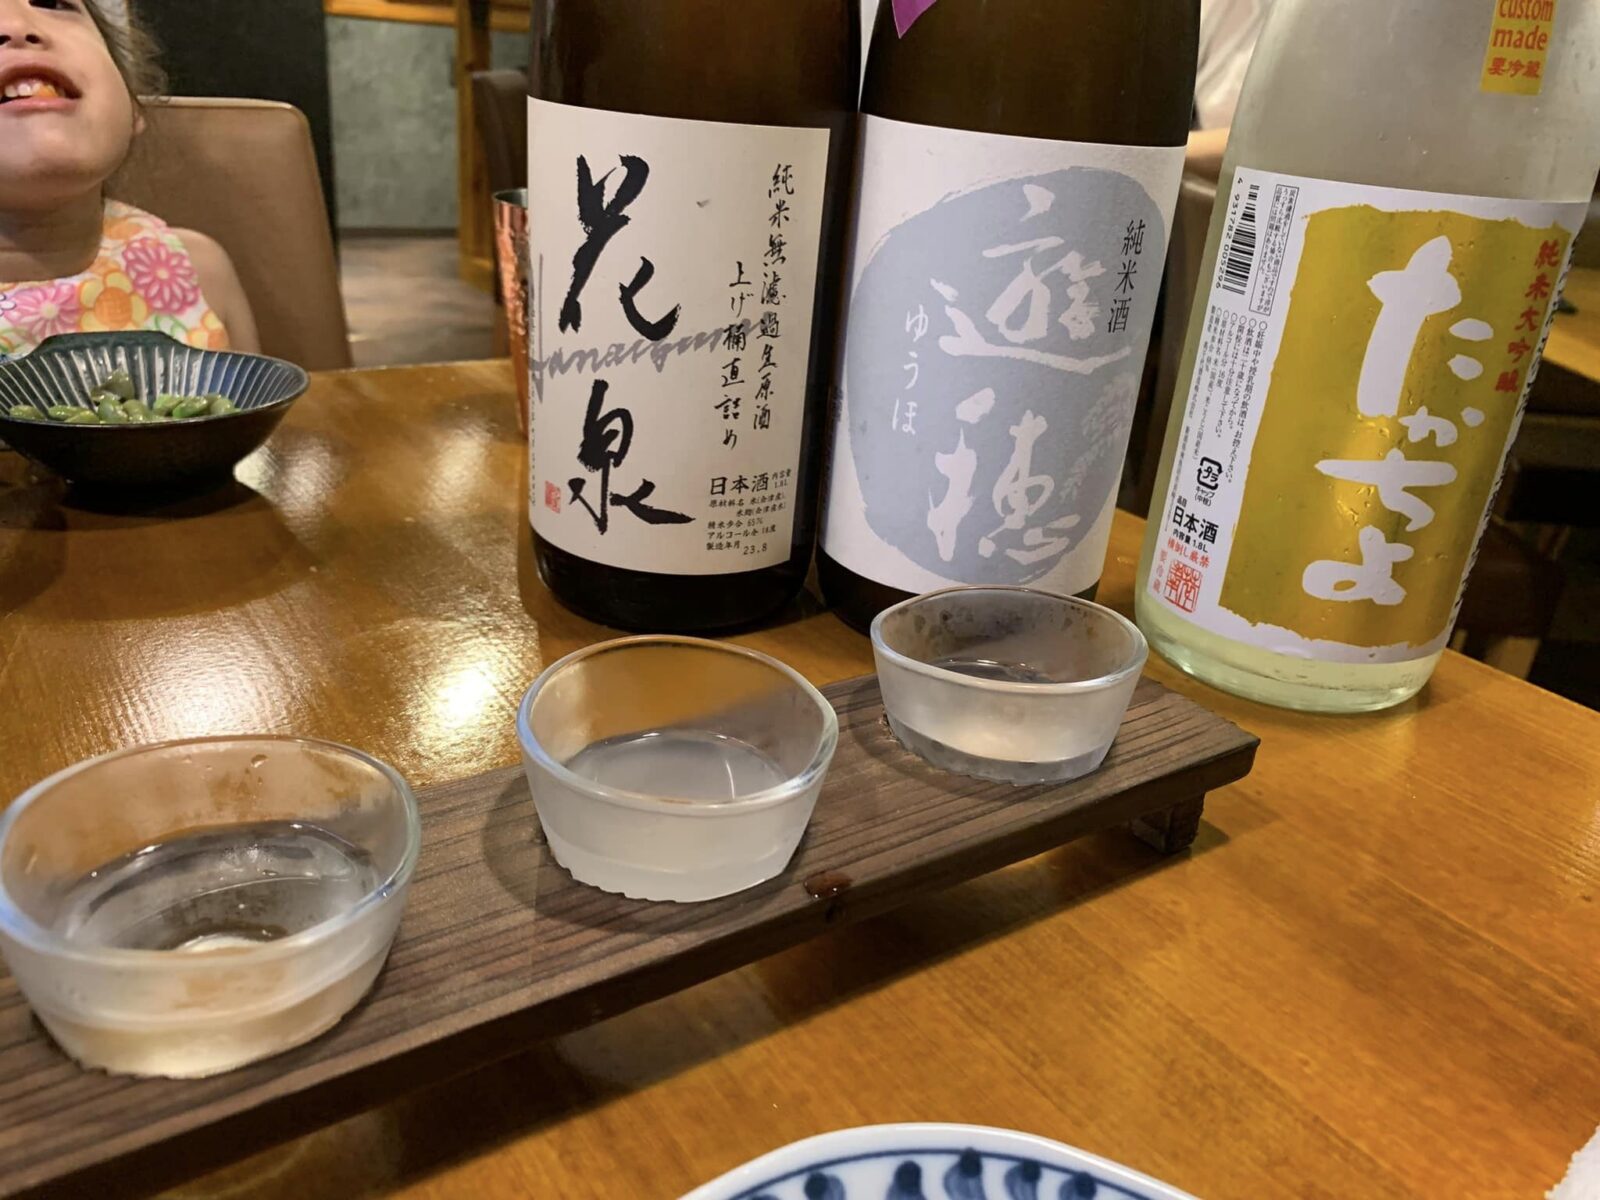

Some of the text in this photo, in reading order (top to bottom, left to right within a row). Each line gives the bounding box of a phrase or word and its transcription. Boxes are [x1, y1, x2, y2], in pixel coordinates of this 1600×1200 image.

[1499, 0, 1554, 22] custom
[1492, 25, 1548, 51] made
[1488, 57, 1541, 78] 要冷蔵
[1107, 218, 1147, 334] 純米酒
[558, 154, 696, 535] 花泉
[891, 304, 930, 436] ゆうほ
[1302, 235, 1494, 606] たかちよ
[709, 472, 770, 496] 日本酒
[1203, 466, 1219, 483] プラ
[1172, 506, 1219, 545] 日本酒
[743, 542, 768, 555] 23.8
